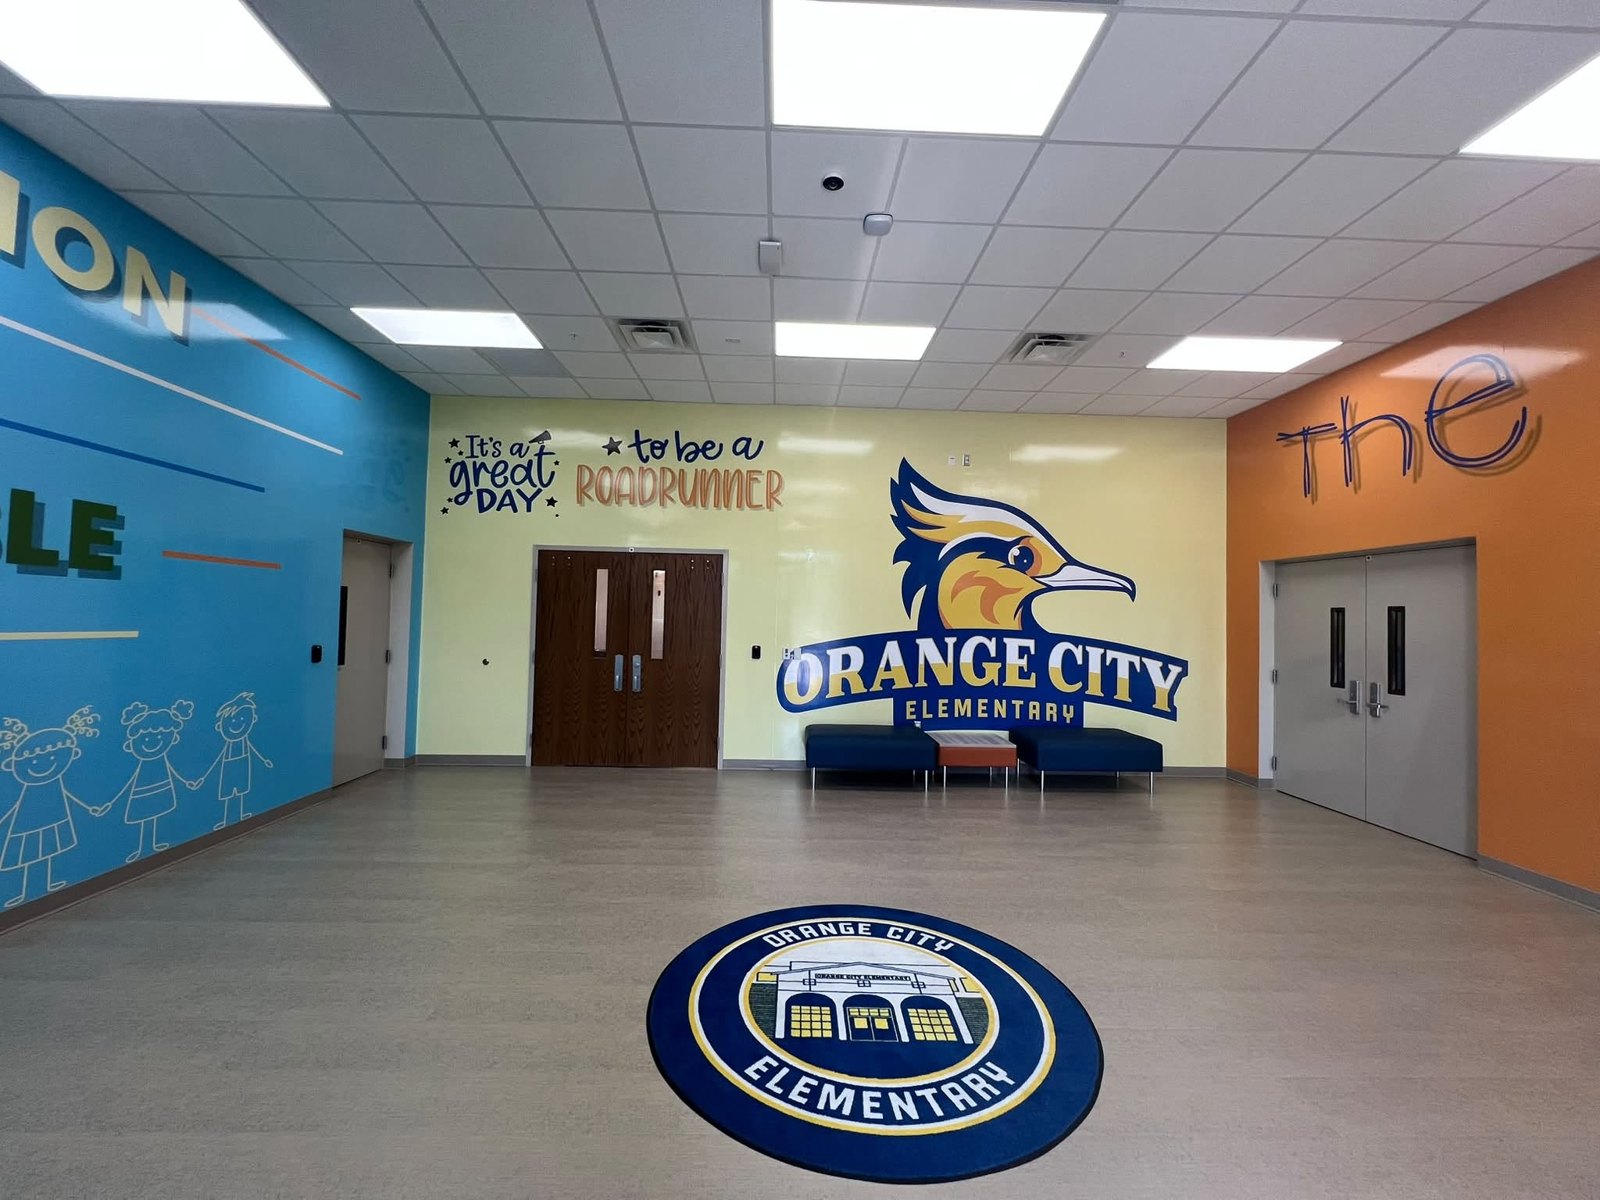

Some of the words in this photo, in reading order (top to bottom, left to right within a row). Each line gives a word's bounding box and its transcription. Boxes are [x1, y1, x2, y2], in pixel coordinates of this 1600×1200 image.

[1276, 353, 1527, 498] The
[465, 435, 502, 459] It's
[509, 442, 531, 459] a
[627, 429, 670, 464] to
[674, 430, 724, 463] be
[732, 436, 765, 461] a
[450, 444, 556, 506] great
[476, 487, 544, 514] DAY
[783, 635, 1038, 705] ORANGE
[1048, 642, 1183, 712] CITY
[905, 698, 1076, 724] ELEMENTARY
[762, 921, 872, 949] ORANGE
[886, 925, 955, 953] CITY
[744, 1055, 1015, 1121] ELEMENTARY
